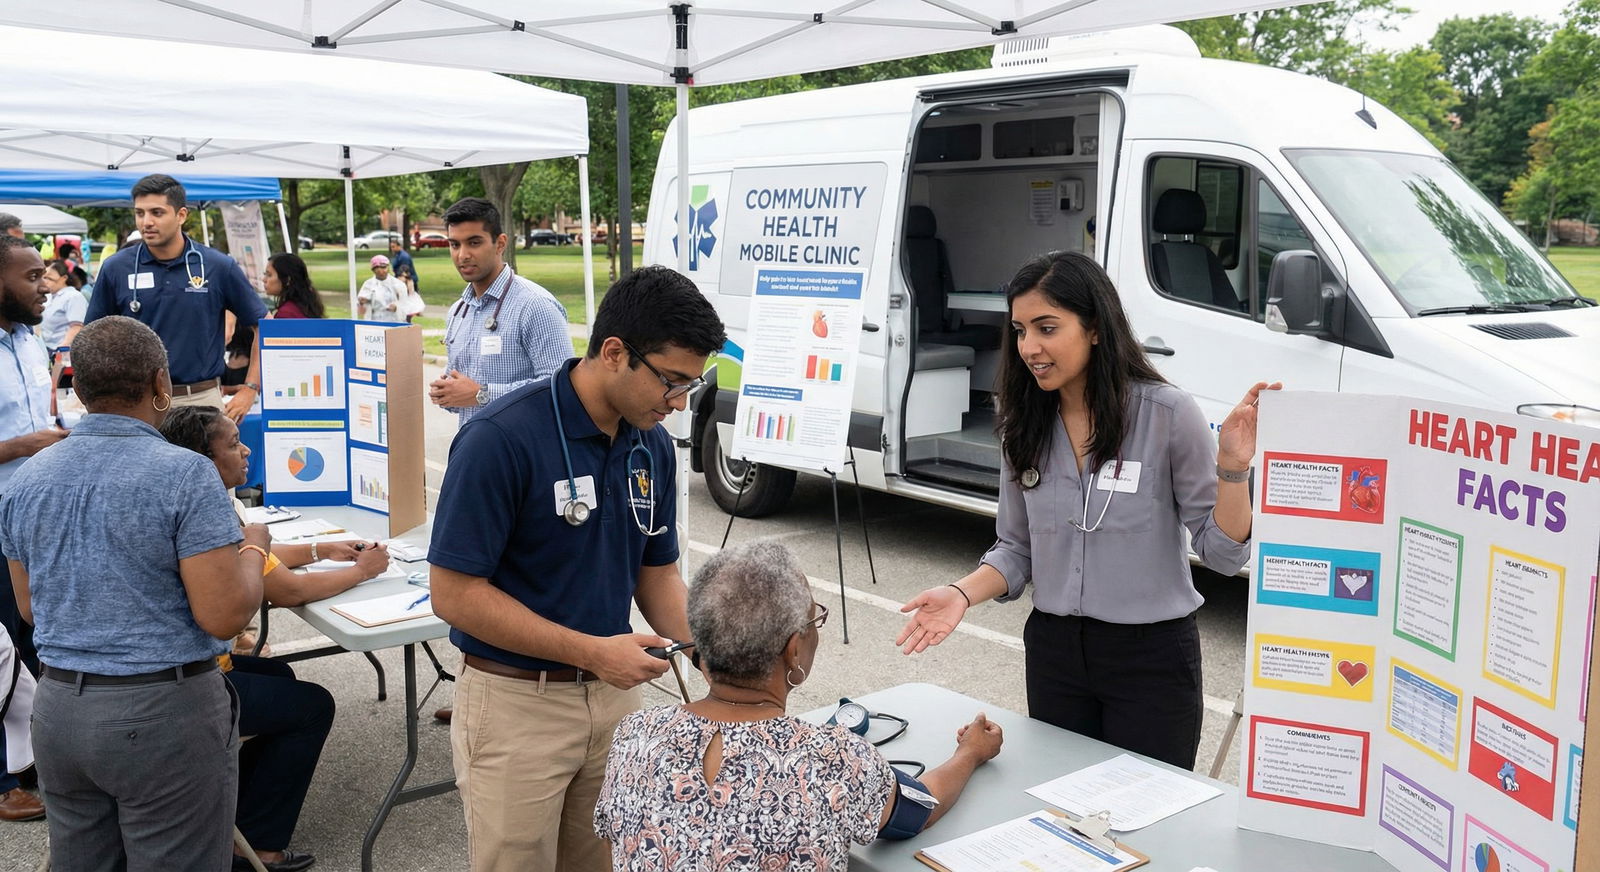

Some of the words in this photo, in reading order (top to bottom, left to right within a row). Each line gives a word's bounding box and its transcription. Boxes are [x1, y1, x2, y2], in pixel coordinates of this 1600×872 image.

[746, 186, 867, 210] COMMUNITY
[762, 216, 838, 238] HEALTH
[739, 243, 799, 263] MOBILE
[803, 245, 860, 266] CLINIC
[1408, 408, 1517, 465] HEART
[1530, 431, 1600, 484] HEA
[1457, 468, 1567, 533] FACTS
